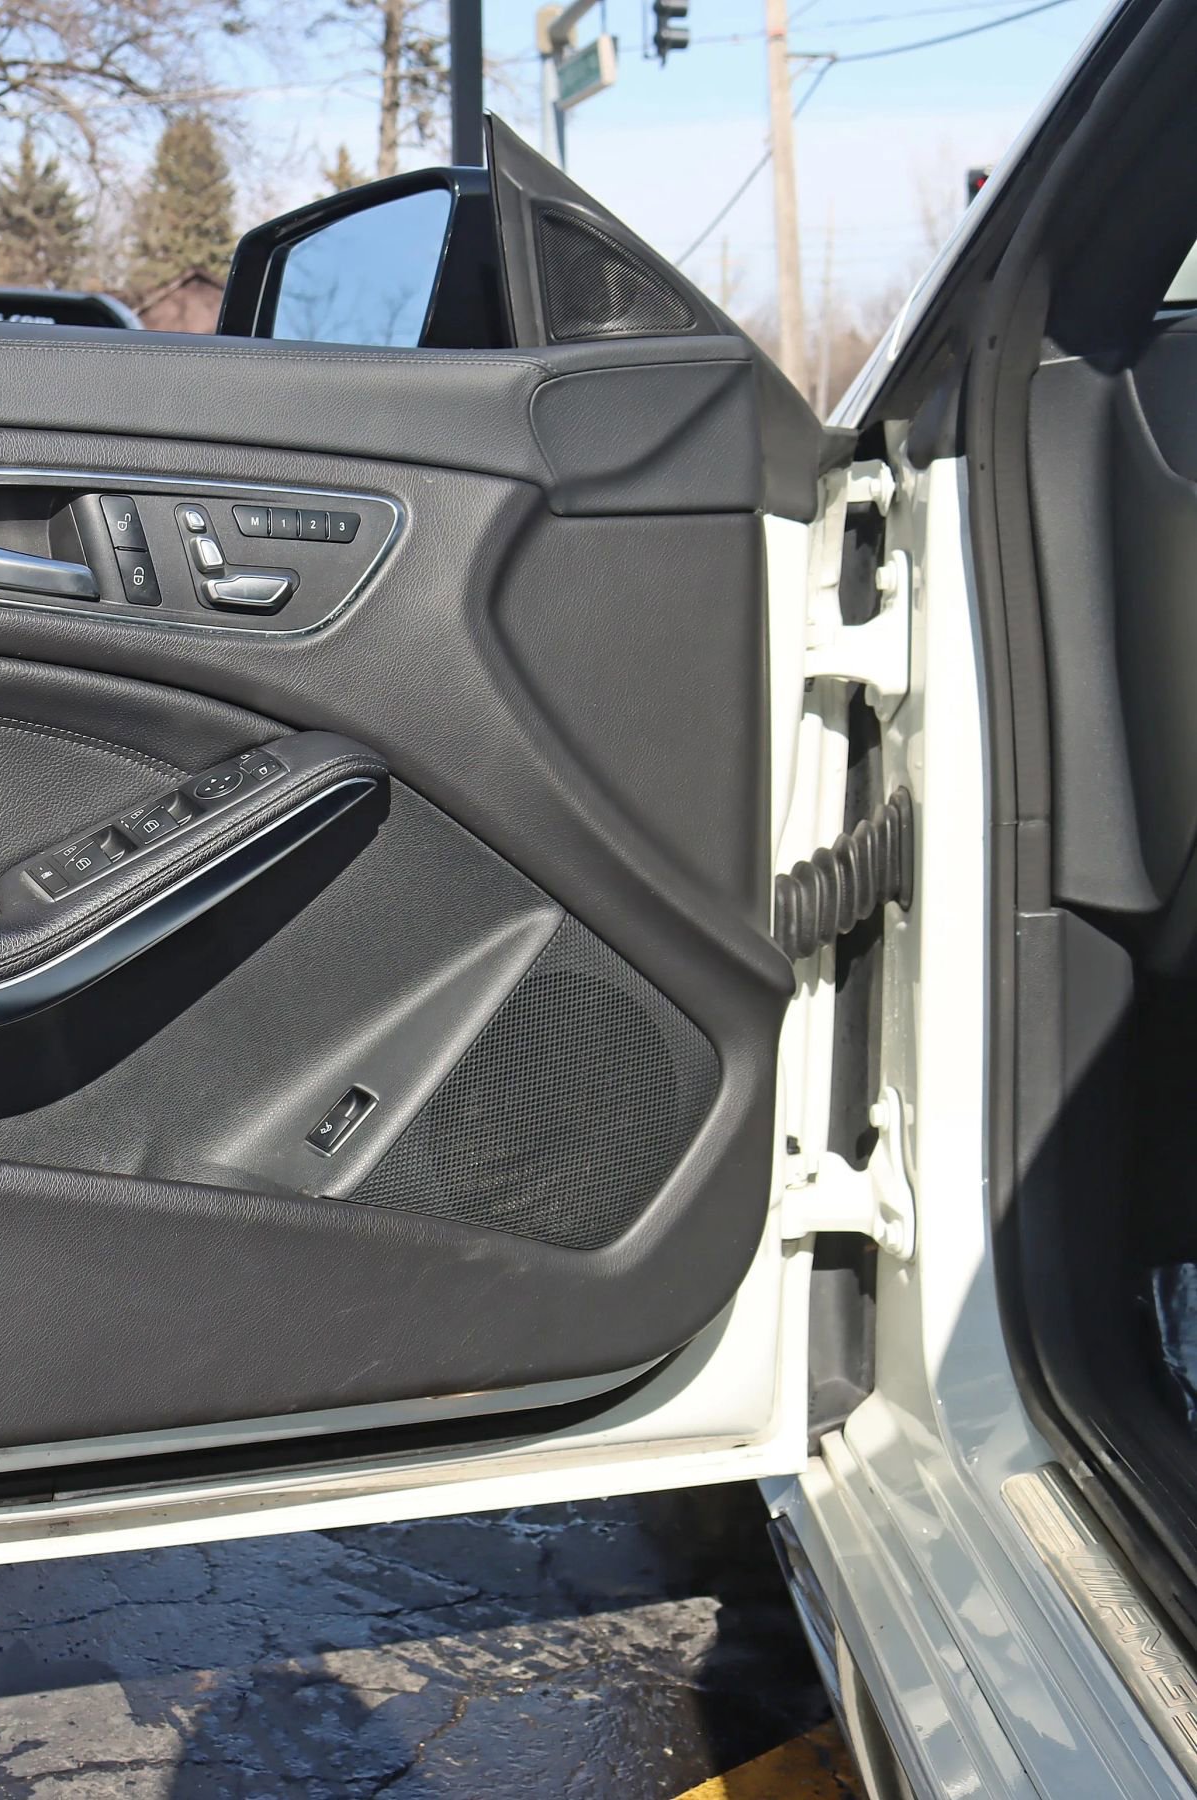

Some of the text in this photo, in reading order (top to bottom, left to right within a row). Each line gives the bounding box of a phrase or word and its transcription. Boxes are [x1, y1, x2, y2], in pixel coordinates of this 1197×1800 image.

[250, 516, 346, 532] M 1 2 3
